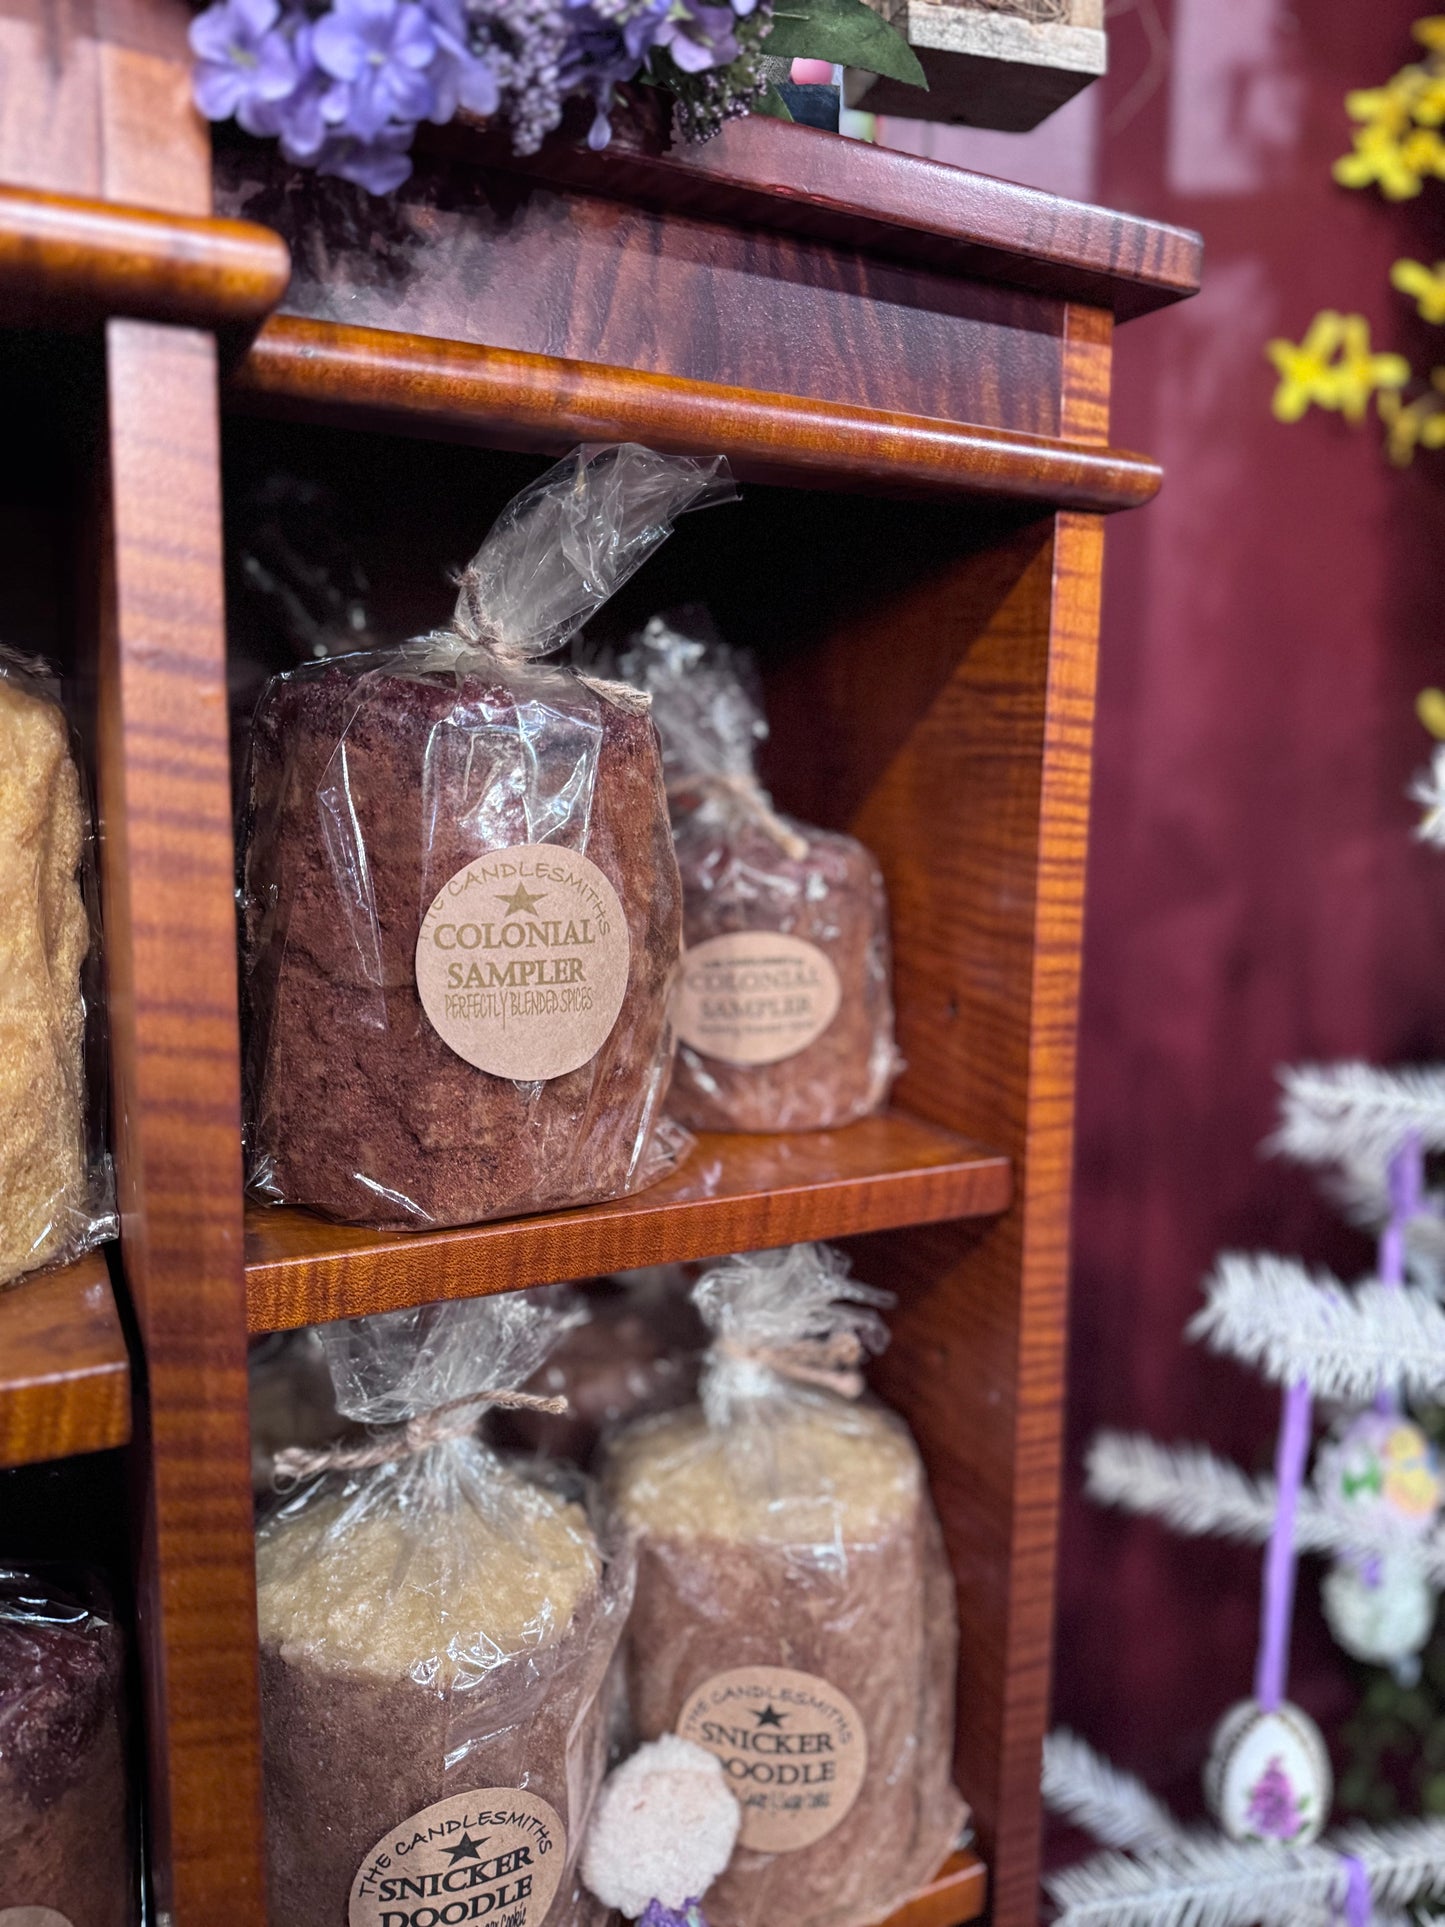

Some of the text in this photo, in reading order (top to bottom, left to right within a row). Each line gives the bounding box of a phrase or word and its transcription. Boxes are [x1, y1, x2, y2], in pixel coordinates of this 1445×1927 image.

[447, 861, 611, 936] CANDLESMITHS
[433, 919, 596, 950] COLONIAL
[447, 957, 587, 990] SAMPLER
[444, 987, 593, 1030] PERFECTLY BLENDED SPICES
[701, 1722, 835, 1755] SNICKER
[711, 1684, 854, 1745] CANDLESMITHS
[720, 1756, 836, 1785] OODLE
[359, 1810, 554, 1898] THE CANDLESMITHS
[378, 1845, 534, 1902] SNICKER
[378, 1873, 534, 1927] DOODLE
